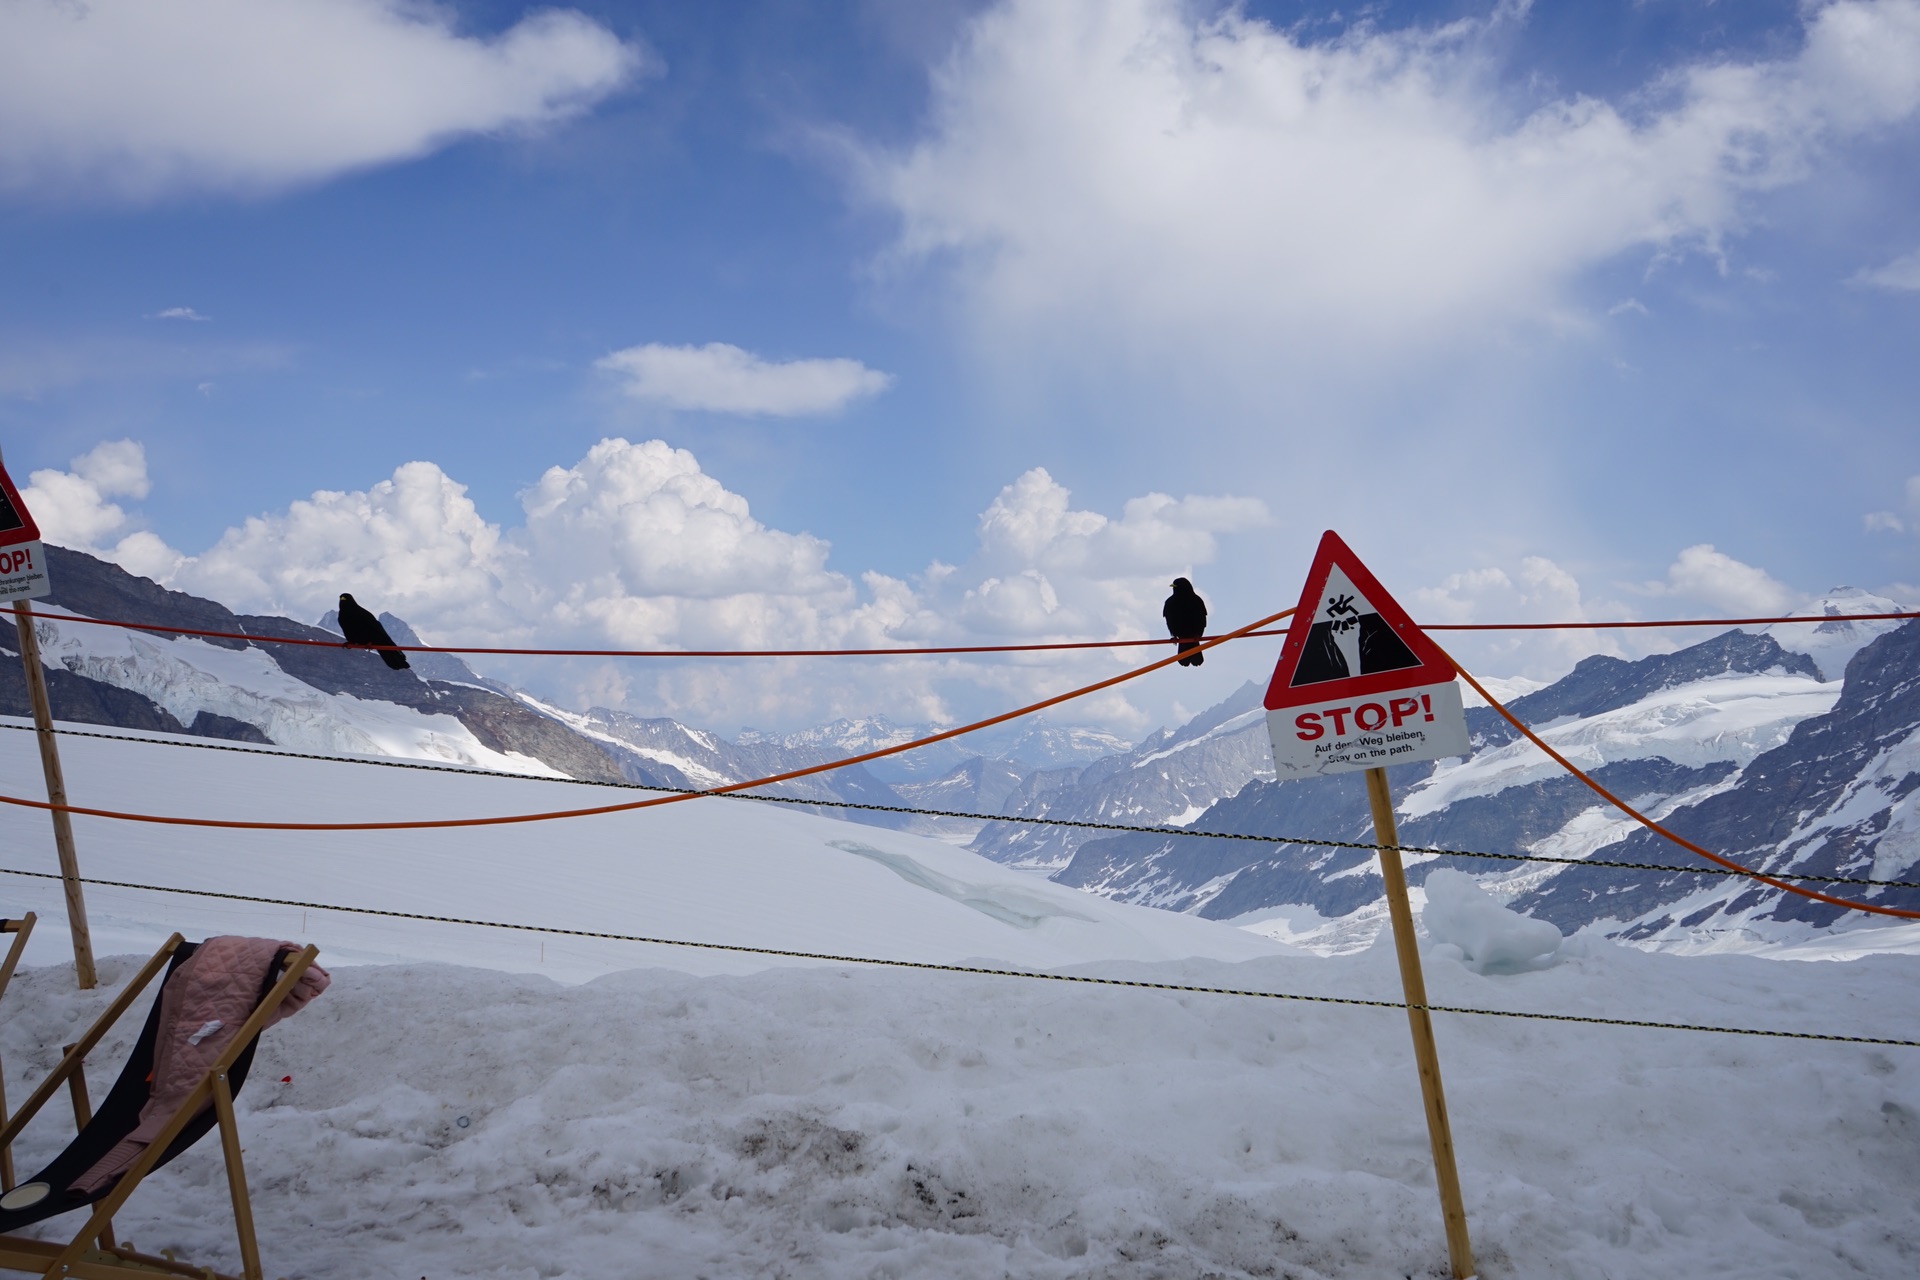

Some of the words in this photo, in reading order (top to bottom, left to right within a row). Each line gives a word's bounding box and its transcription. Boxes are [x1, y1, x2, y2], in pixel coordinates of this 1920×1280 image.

[1295, 694, 1435, 741] STOP!
[1314, 742, 1332, 754] Auf
[1358, 736, 1384, 747] Weg
[1386, 730, 1426, 743] bleiben.
[1328, 753, 1351, 764] Stay
[1354, 751, 1367, 760] on
[1370, 748, 1387, 757] the
[1389, 743, 1416, 756] path.
